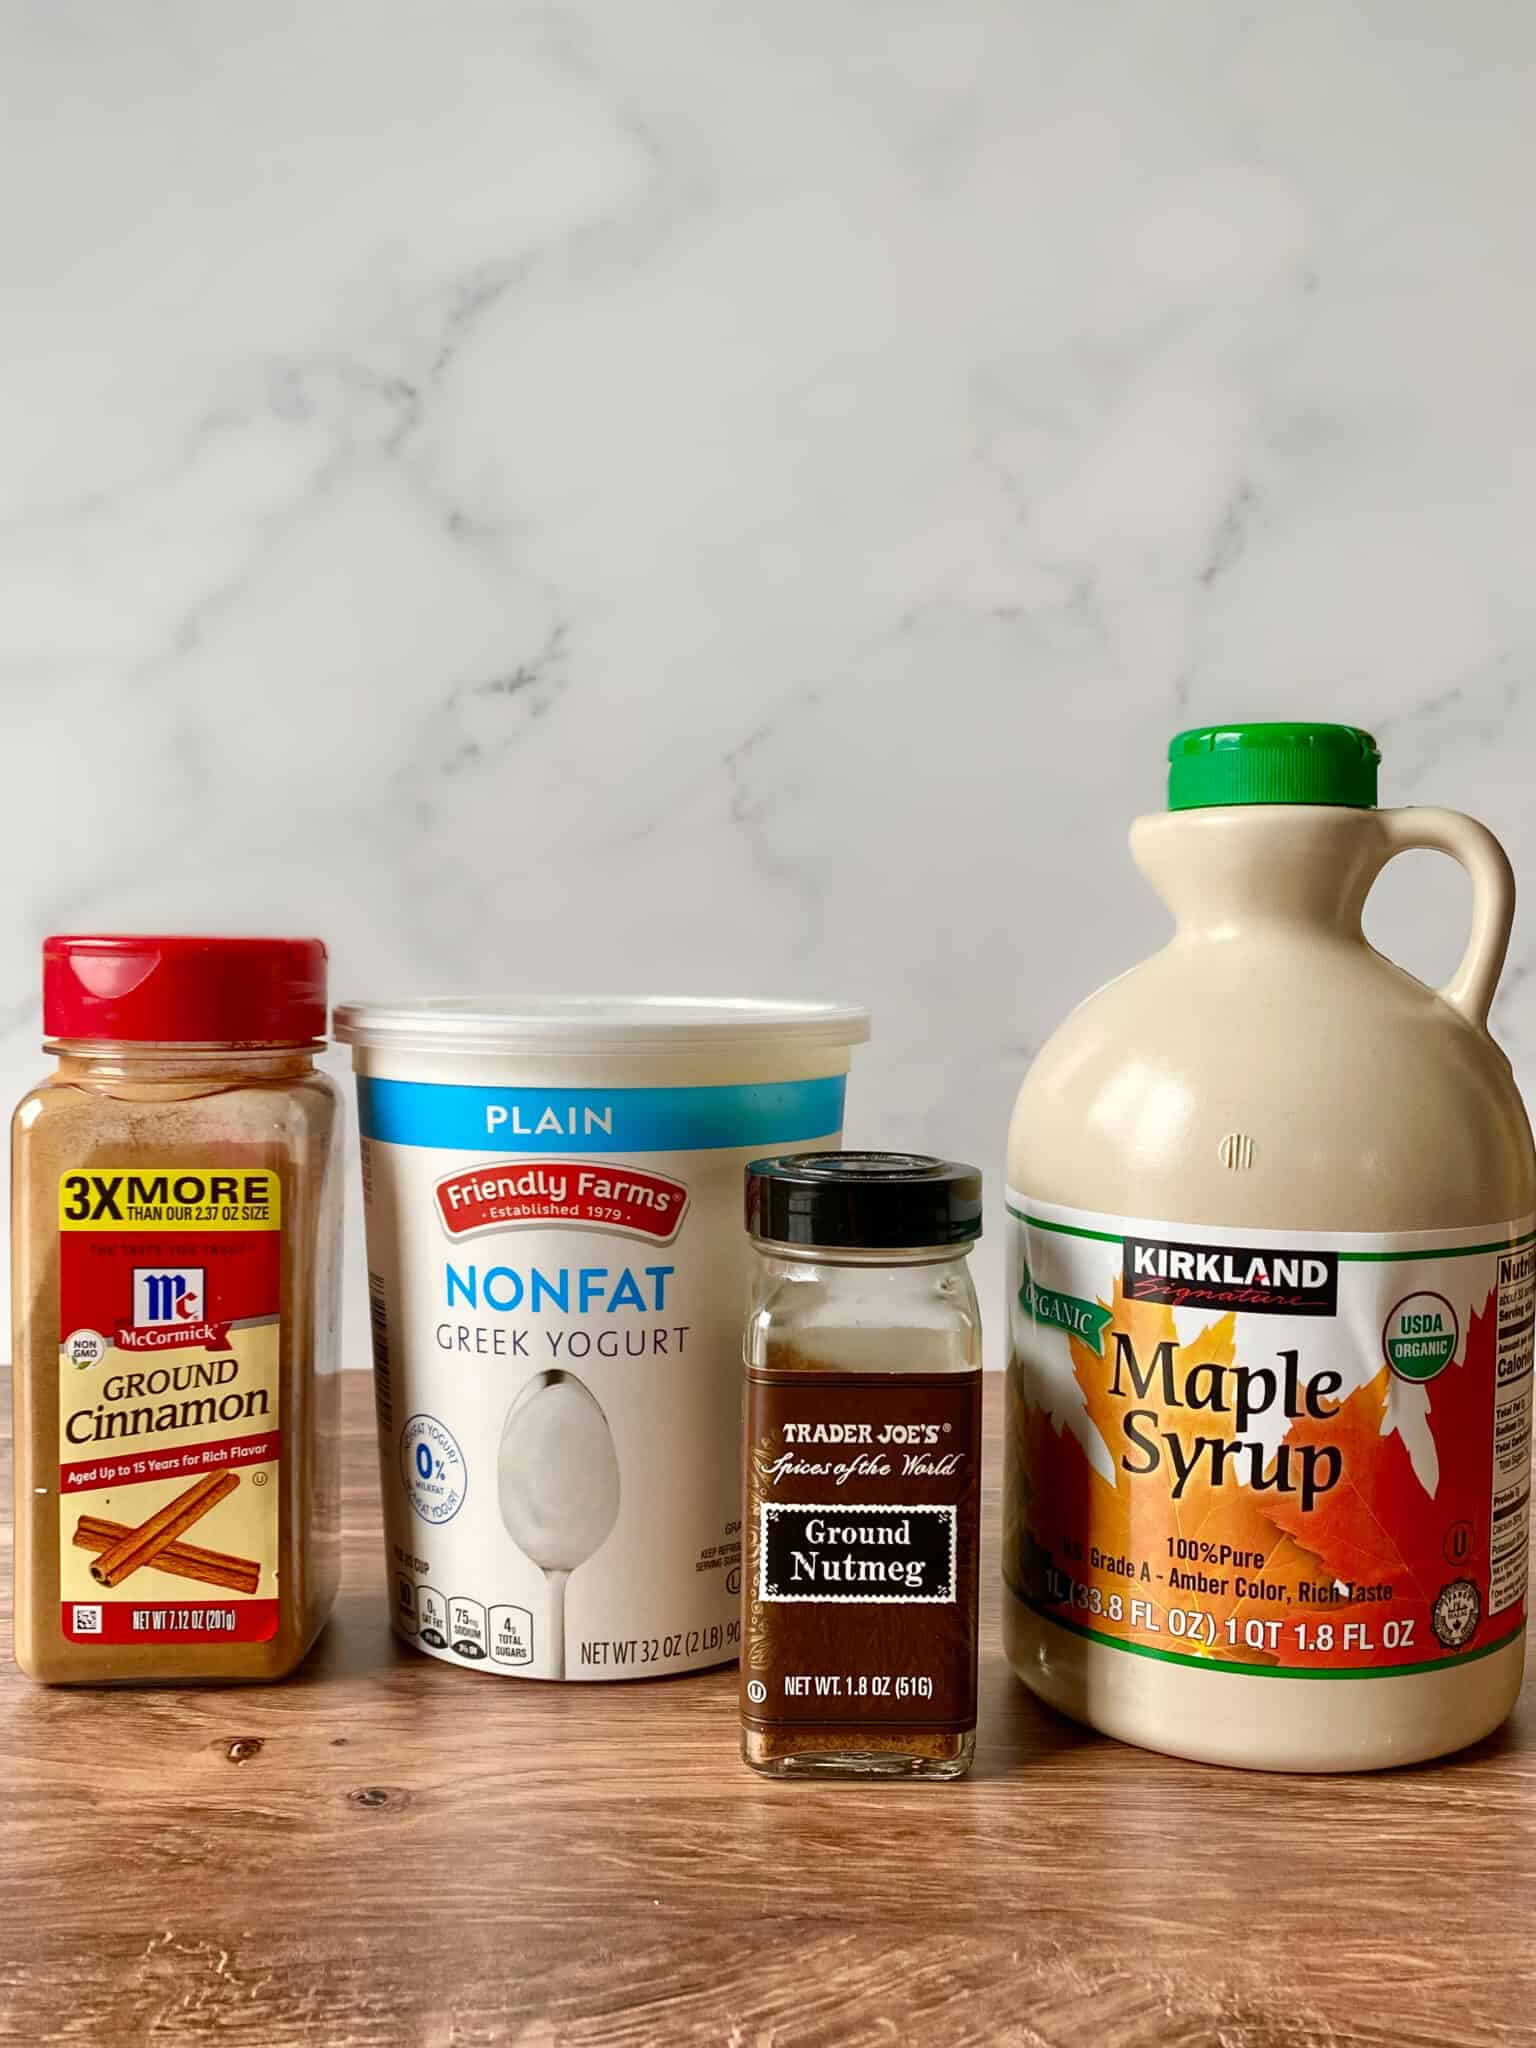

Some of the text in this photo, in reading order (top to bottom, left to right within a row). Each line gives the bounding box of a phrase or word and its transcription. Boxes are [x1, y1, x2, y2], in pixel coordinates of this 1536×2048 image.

[486, 1104, 613, 1135] PLAIN
[64, 1176, 269, 1221] 3X MORE
[447, 1170, 567, 1210] Friendly
[127, 1206, 270, 1221] THAN OUR 2.37 OZ SIZE
[490, 1203, 622, 1222] Established 1979
[1133, 1246, 1328, 1289] KIRKLAND
[445, 1263, 675, 1313] NONFAT
[1132, 1277, 1328, 1305] Signature
[1025, 1283, 1093, 1335] ORGANIC
[1401, 1313, 1443, 1335] USDA
[74, 1340, 97, 1349] NON
[119, 1324, 217, 1347] McCormick
[436, 1323, 691, 1358] GREEK YOGURT
[1395, 1340, 1448, 1358] ORGANIC
[74, 1349, 97, 1358] GMO
[103, 1359, 239, 1401] GROUND
[1108, 1331, 1343, 1433] Maple
[65, 1387, 271, 1444] Cinnamon
[782, 1423, 940, 1444] TRADER JOE'S
[68, 1444, 269, 1485] Aged Up to 15 Years for Rich Flavor
[416, 1442, 446, 1481] 0%
[760, 1451, 966, 1486] Spices of the World
[1120, 1409, 1342, 1513] Syrup
[805, 1519, 912, 1545] Ground
[790, 1551, 926, 1587] Nutmeg
[1091, 1546, 1135, 1578] Grade
[1140, 1560, 1152, 1584] A
[1168, 1567, 1229, 1598] Amber
[1234, 1574, 1293, 1605] Color,
[1299, 1579, 1338, 1602] Rich
[1347, 1581, 1393, 1602] Taste
[132, 1609, 236, 1631] NET WT 7.12 OZ (201g)
[1070, 1579, 1123, 1622] (33.8
[1130, 1598, 1160, 1633] FL
[1168, 1607, 1215, 1647] OZ)
[1225, 1618, 1238, 1646] 1
[1244, 1621, 1283, 1650] QT
[1295, 1621, 1334, 1651] 1.8
[1343, 1621, 1374, 1650] FL
[1382, 1620, 1415, 1648] OZ
[495, 1646, 527, 1658] SUGARS
[498, 1633, 522, 1646] TOTAL
[581, 1642, 609, 1664] NET
[612, 1640, 637, 1664] WT
[641, 1639, 659, 1663] 32
[663, 1635, 682, 1658] OZ
[685, 1631, 700, 1657] (2
[703, 1624, 723, 1651] LB)
[784, 1675, 933, 1700] NET WT. 1.8 OZ (51G)
